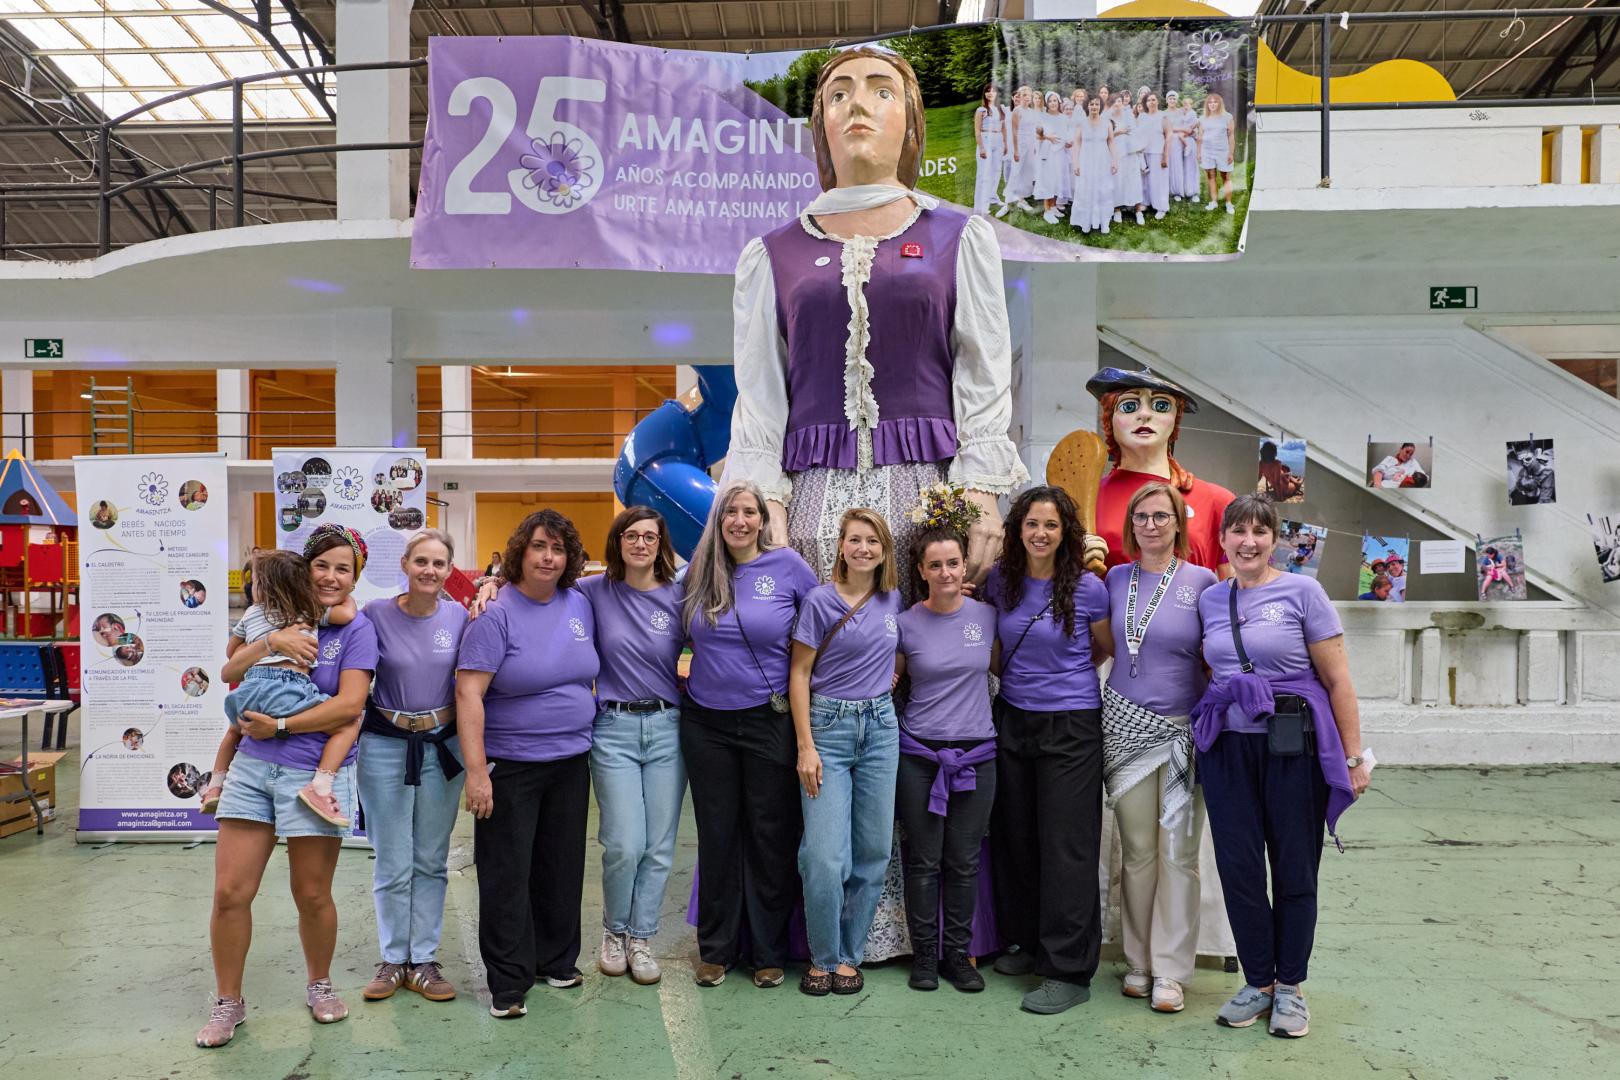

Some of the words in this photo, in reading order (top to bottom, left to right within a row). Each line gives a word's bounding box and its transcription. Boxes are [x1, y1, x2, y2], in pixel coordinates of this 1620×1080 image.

[617, 112, 816, 154] AMAGINT
[444, 76, 607, 215] 25
[615, 164, 664, 186] AÑOS
[671, 170, 815, 190] ACOMPAÑANDO
[614, 194, 658, 214] URTE
[665, 198, 789, 218] AMATASUNAK
[154, 519, 186, 528] NACIDOS
[121, 530, 145, 538] ANTES
[147, 530, 157, 538] DE
[159, 529, 186, 537] TIEMPO
[121, 810, 188, 819] www.amagintza.org
[117, 819, 192, 828] amagintza@gmail.com
